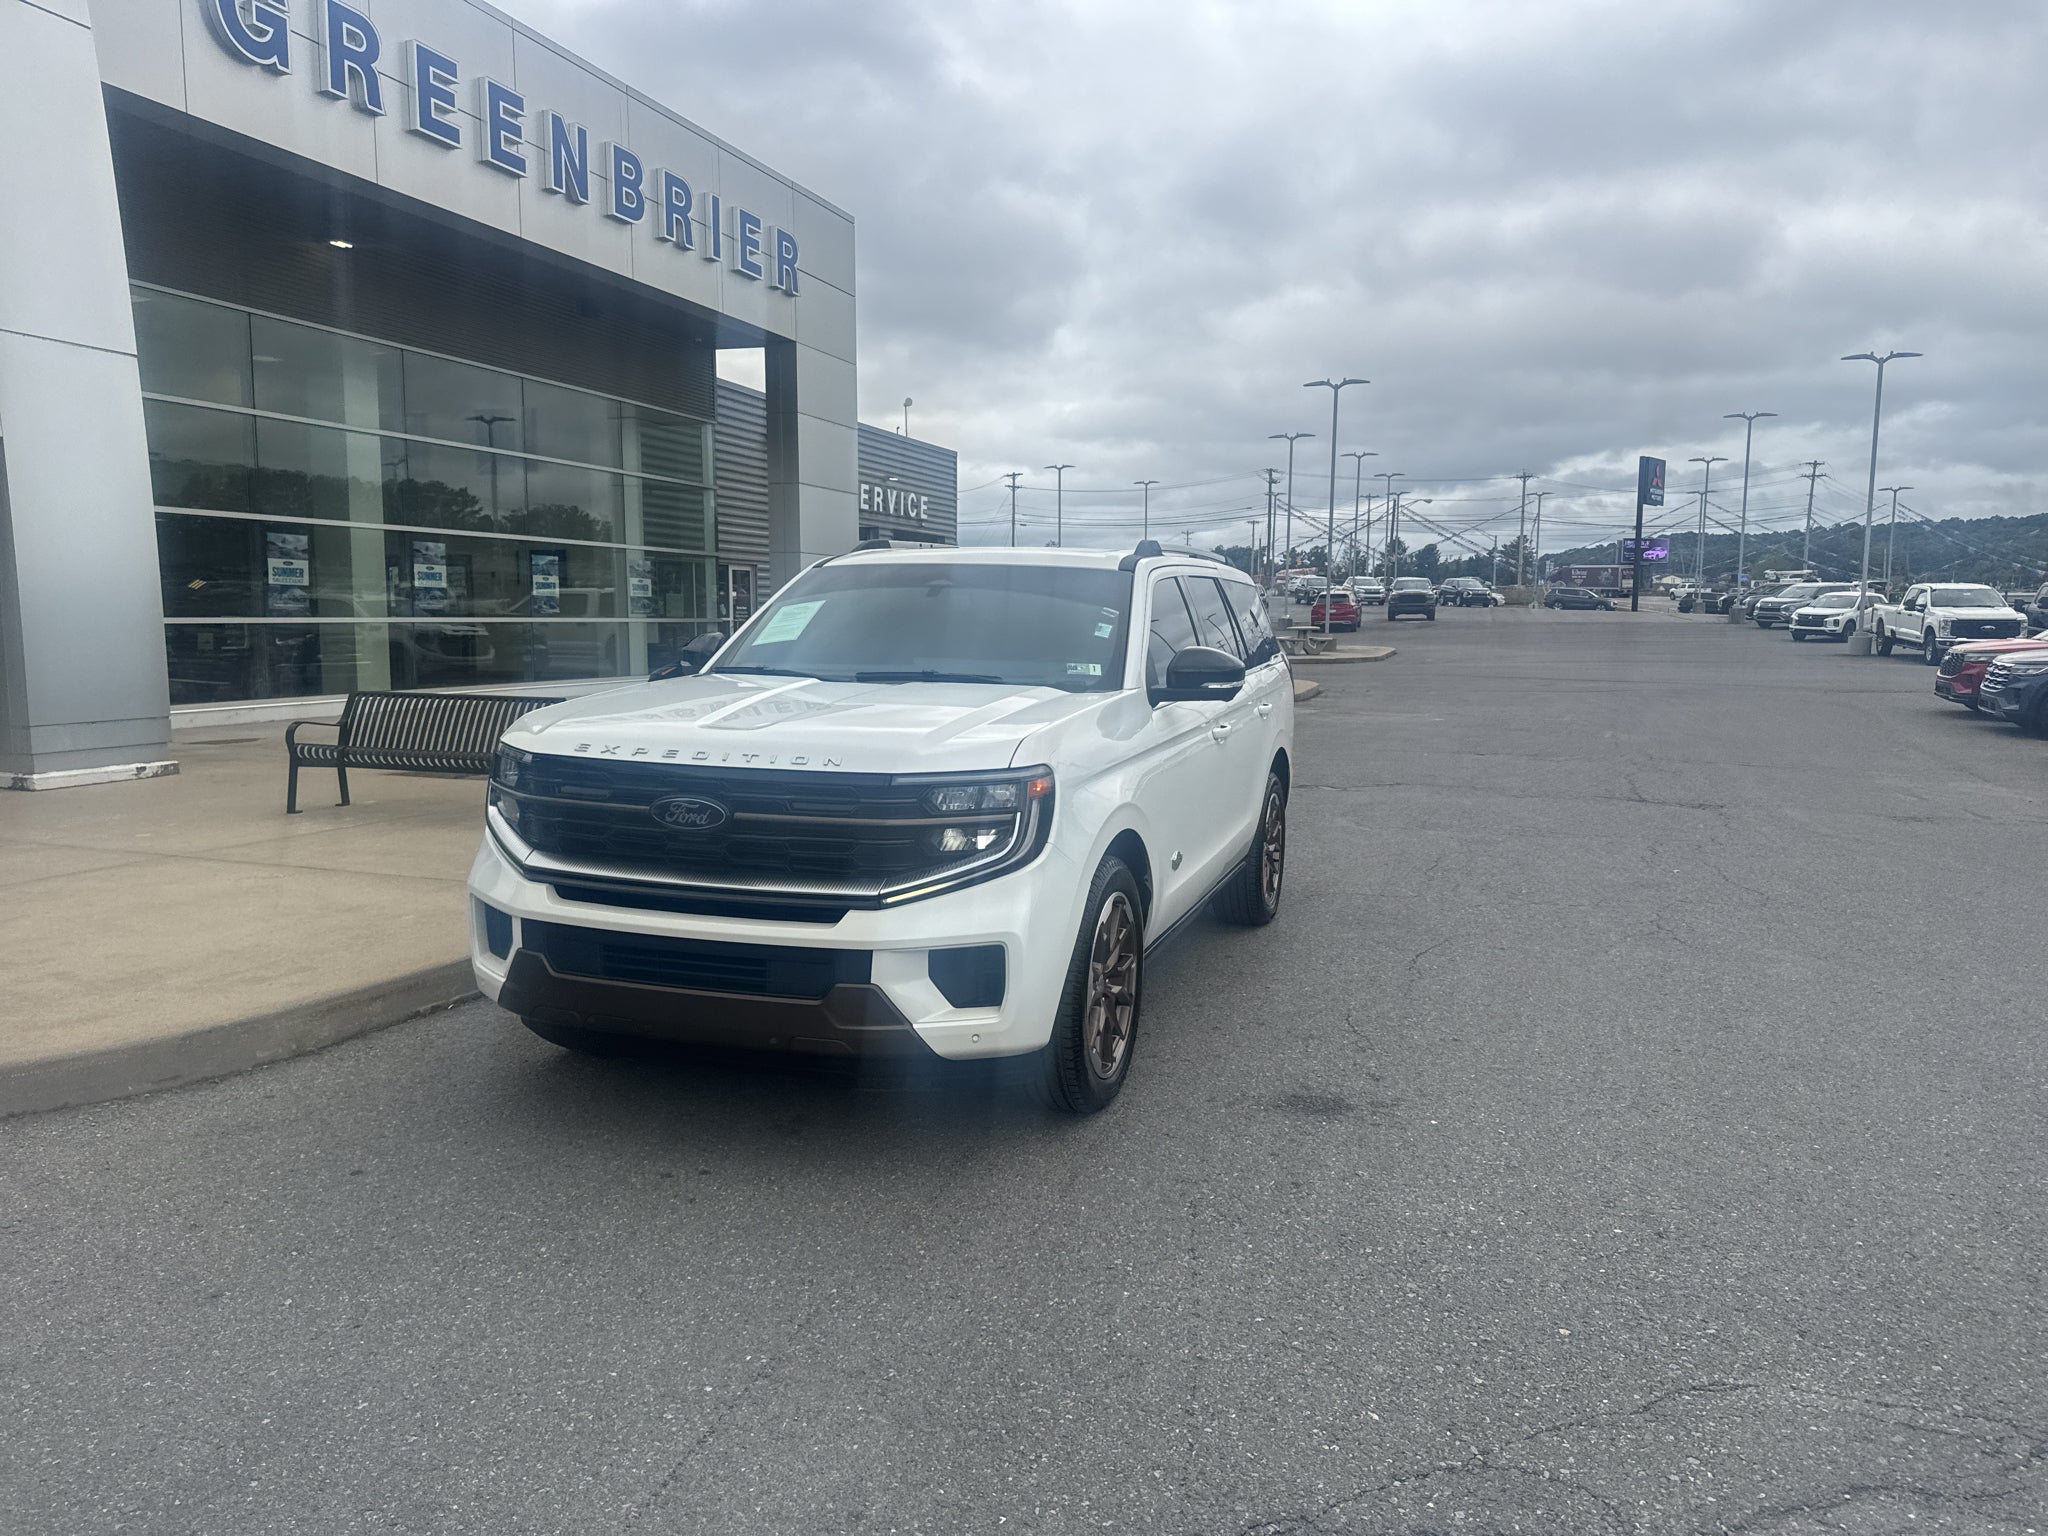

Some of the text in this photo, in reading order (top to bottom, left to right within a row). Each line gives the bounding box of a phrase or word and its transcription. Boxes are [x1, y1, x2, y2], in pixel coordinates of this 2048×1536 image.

[208, 0, 800, 297] GREENBRIER
[860, 483, 928, 519] ERVICE
[271, 566, 305, 579] SUMMER
[573, 743, 844, 767] EXPEDITION
[665, 801, 711, 825] Ford
